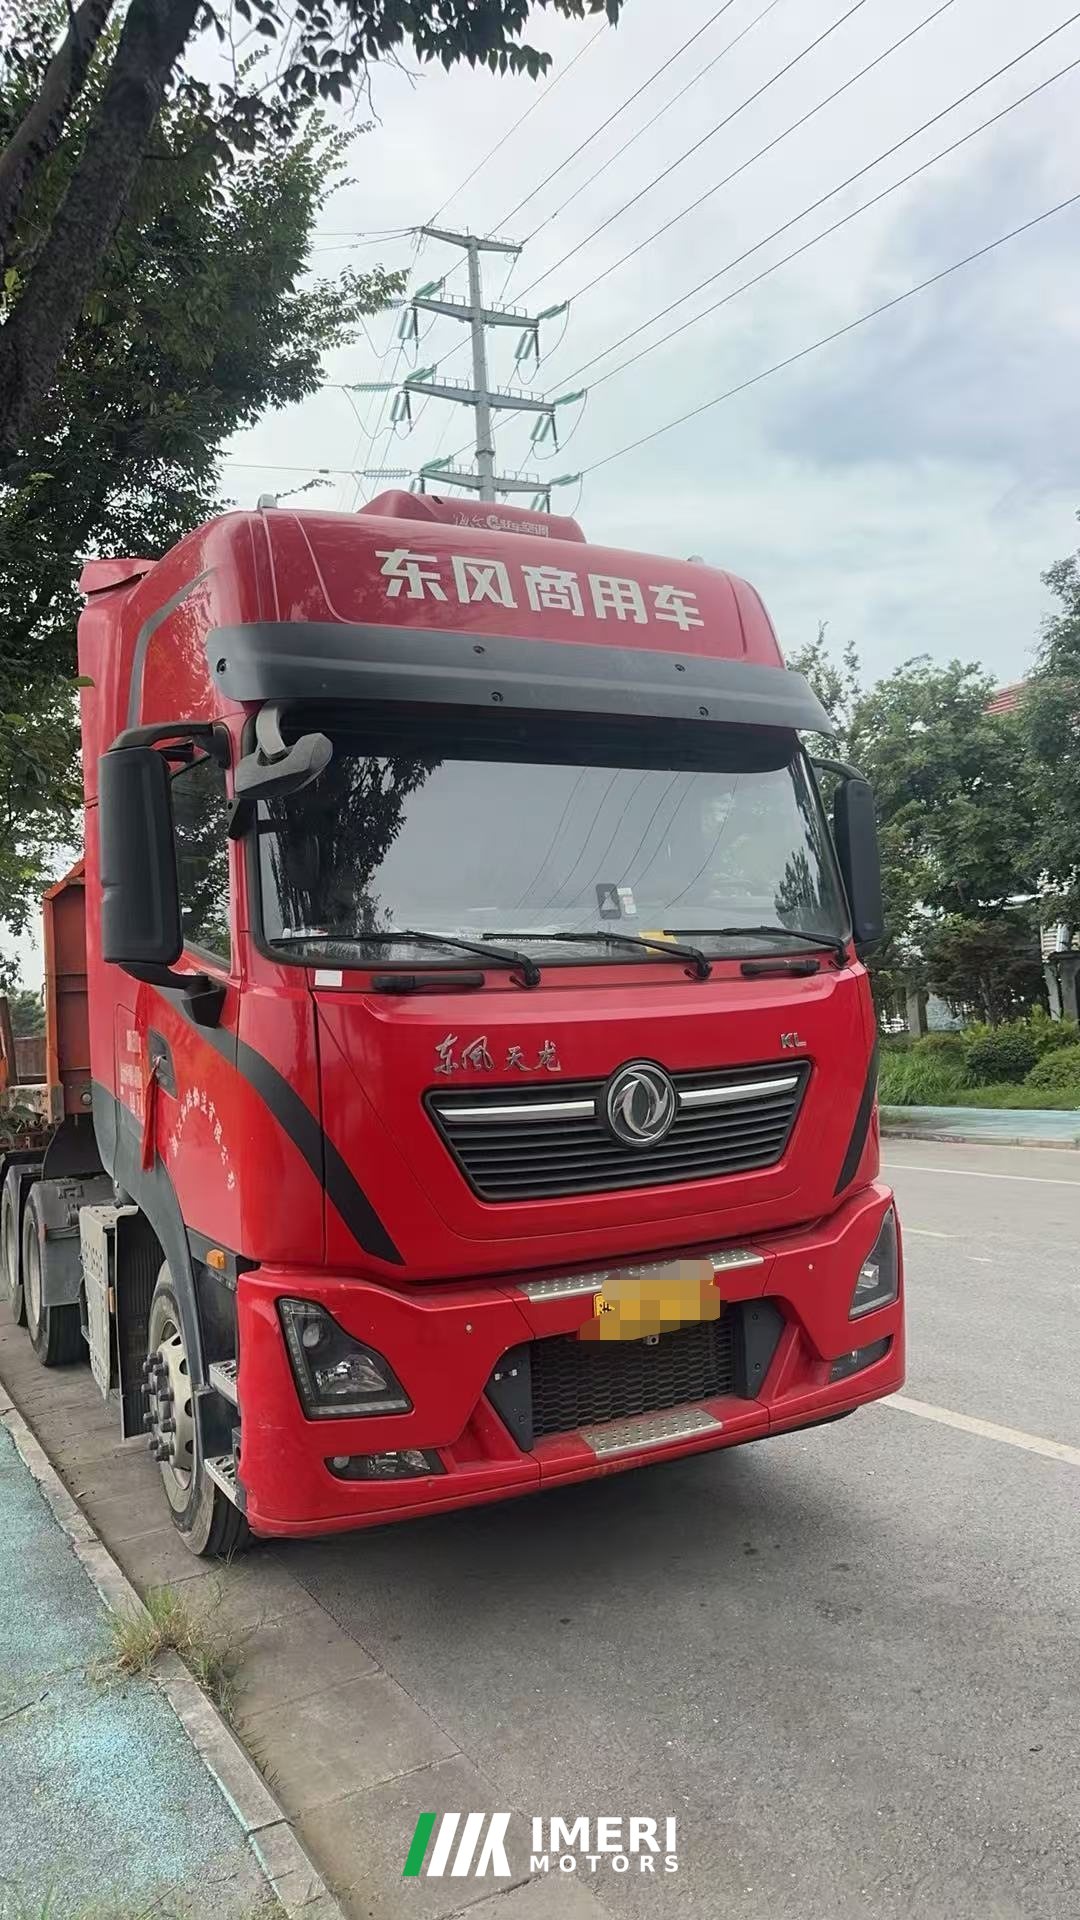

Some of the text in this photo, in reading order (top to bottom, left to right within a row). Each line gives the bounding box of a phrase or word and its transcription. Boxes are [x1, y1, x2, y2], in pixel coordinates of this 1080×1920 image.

[375, 549, 705, 631] 东风商用车
[780, 1032, 807, 1049] KL
